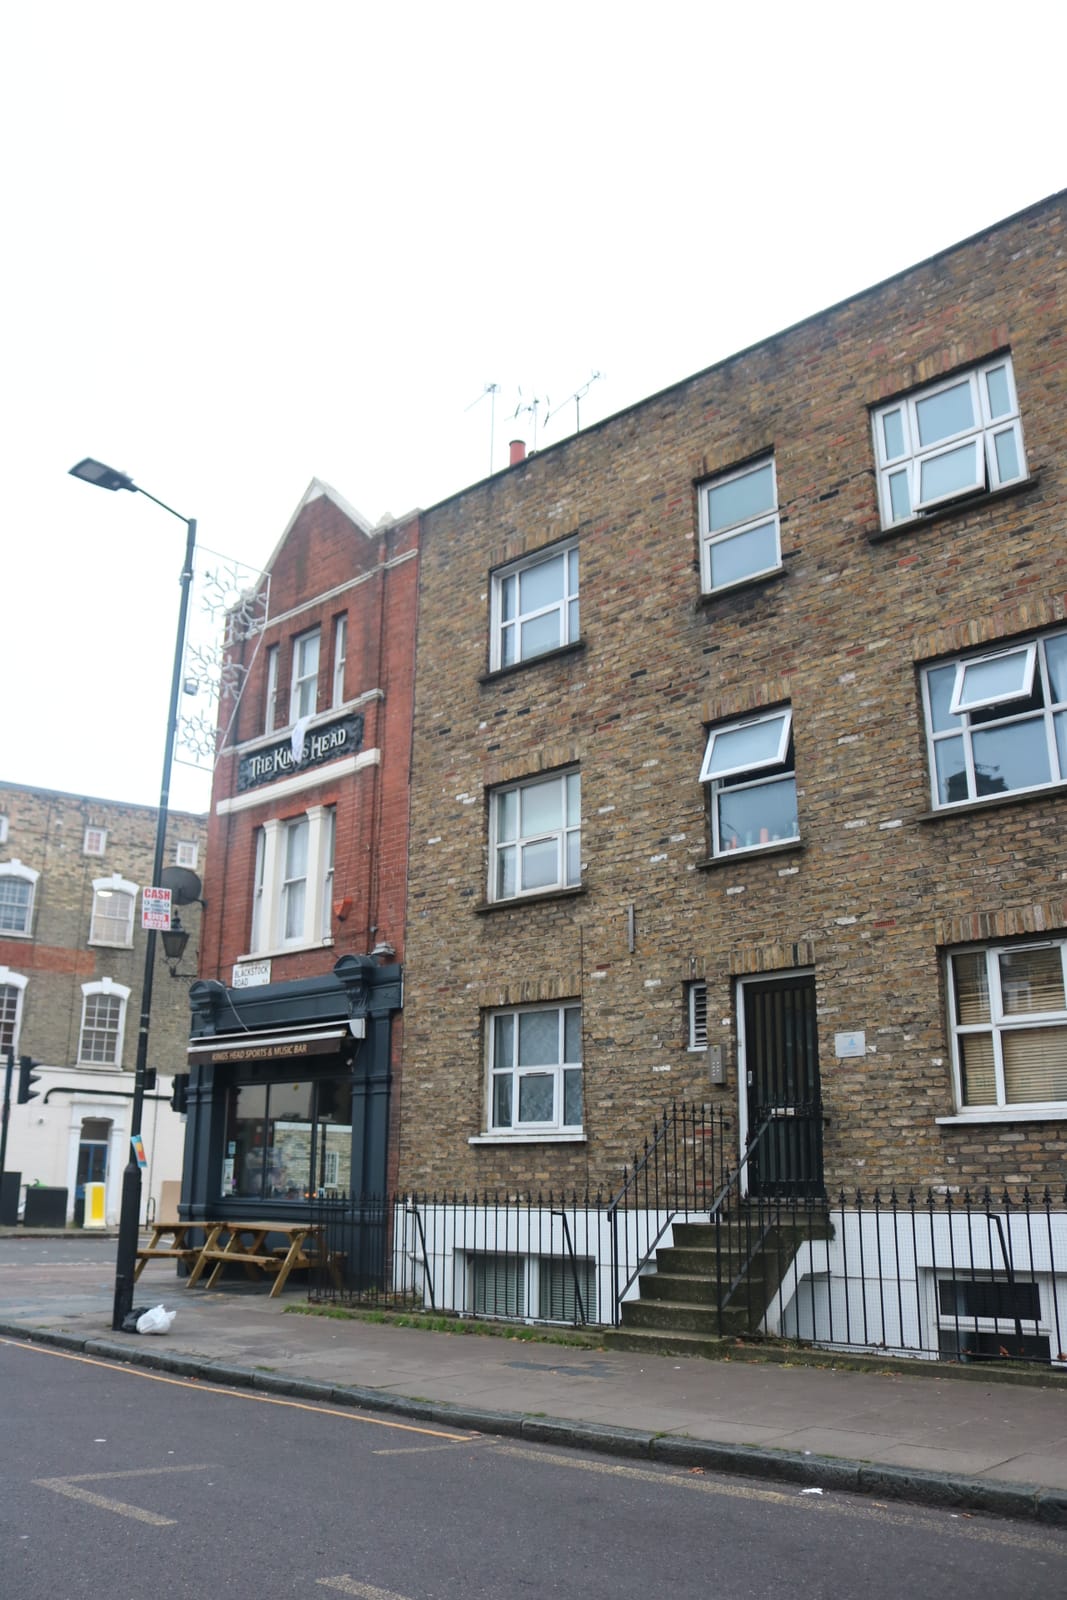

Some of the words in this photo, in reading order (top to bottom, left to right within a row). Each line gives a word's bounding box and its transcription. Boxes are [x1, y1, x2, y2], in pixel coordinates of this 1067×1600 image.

[273, 743, 310, 773] KINS
[144, 888, 170, 900] CASH
[234, 967, 269, 978] BLACKSTOCK
[234, 977, 249, 986] ROAD
[229, 1050, 245, 1060] HEAD
[245, 1048, 268, 1059] SPORTS
[273, 1045, 293, 1055] MUSIC
[293, 1044, 308, 1054] BAR
